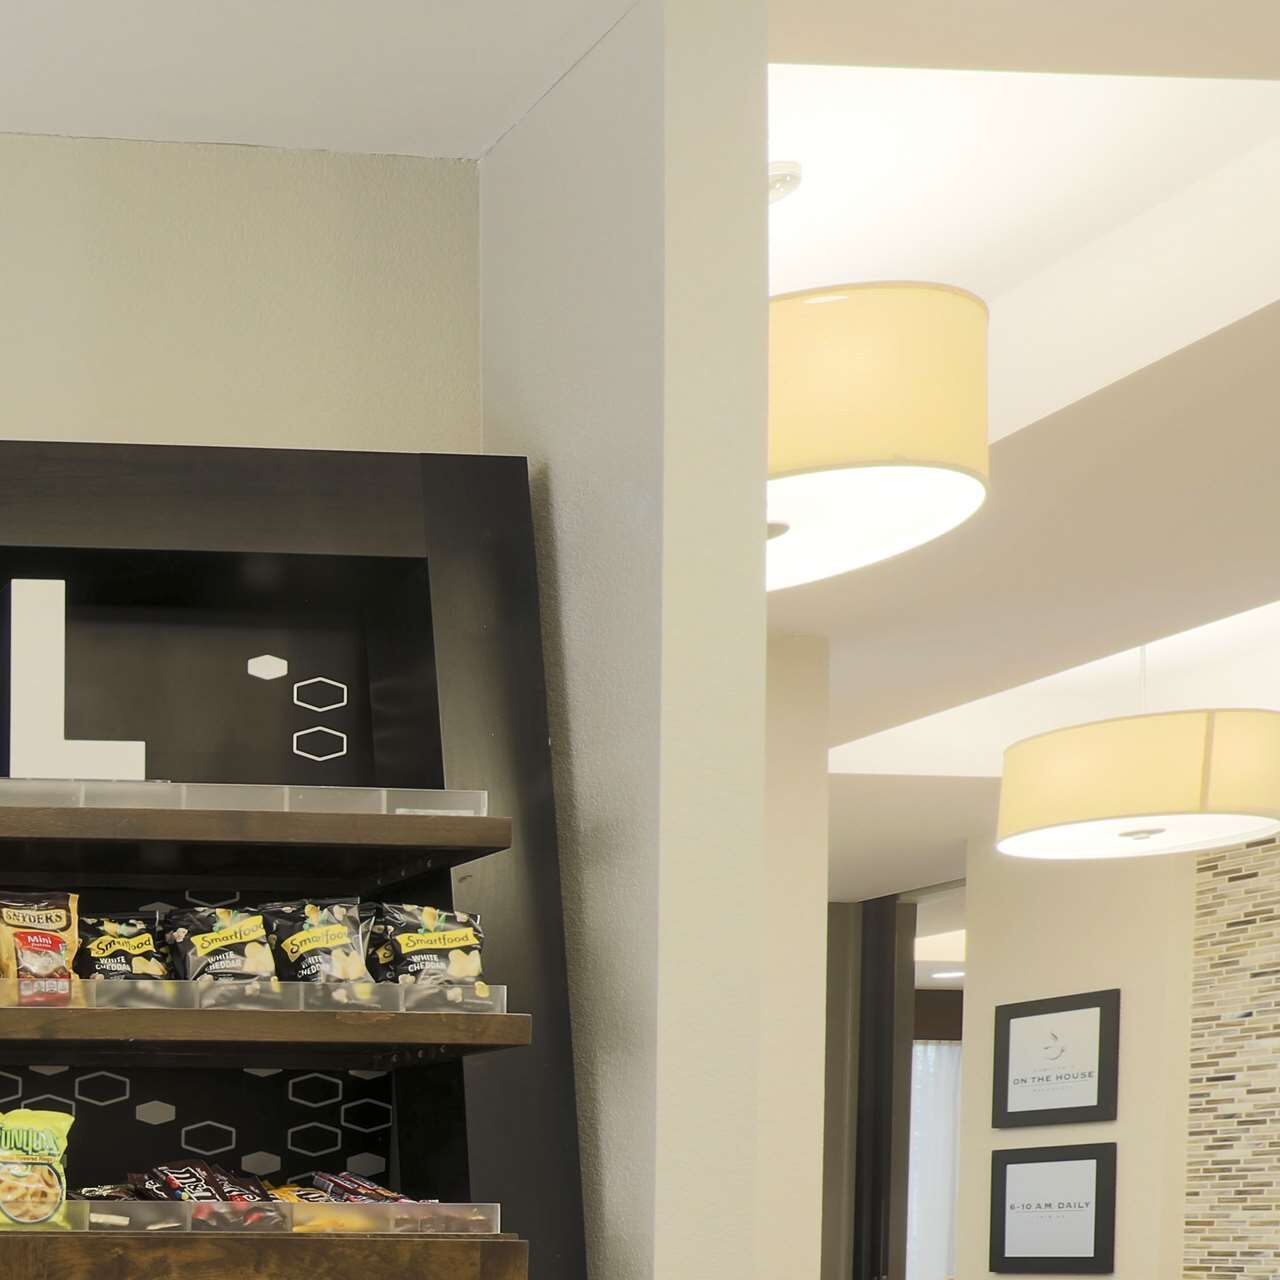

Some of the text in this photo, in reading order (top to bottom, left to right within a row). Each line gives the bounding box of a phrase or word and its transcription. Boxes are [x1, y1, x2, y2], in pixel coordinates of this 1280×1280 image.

[28, 935, 52, 945] Mini
[201, 923, 264, 950] Smartfood
[405, 934, 469, 948] Smartfood
[207, 951, 235, 964] WHITE
[411, 954, 439, 962] WHITE
[1013, 1071, 1095, 1086] ON THE HOUSE
[1035, 1202, 1052, 1210] AM
[1057, 1201, 1090, 1209] DAILY
